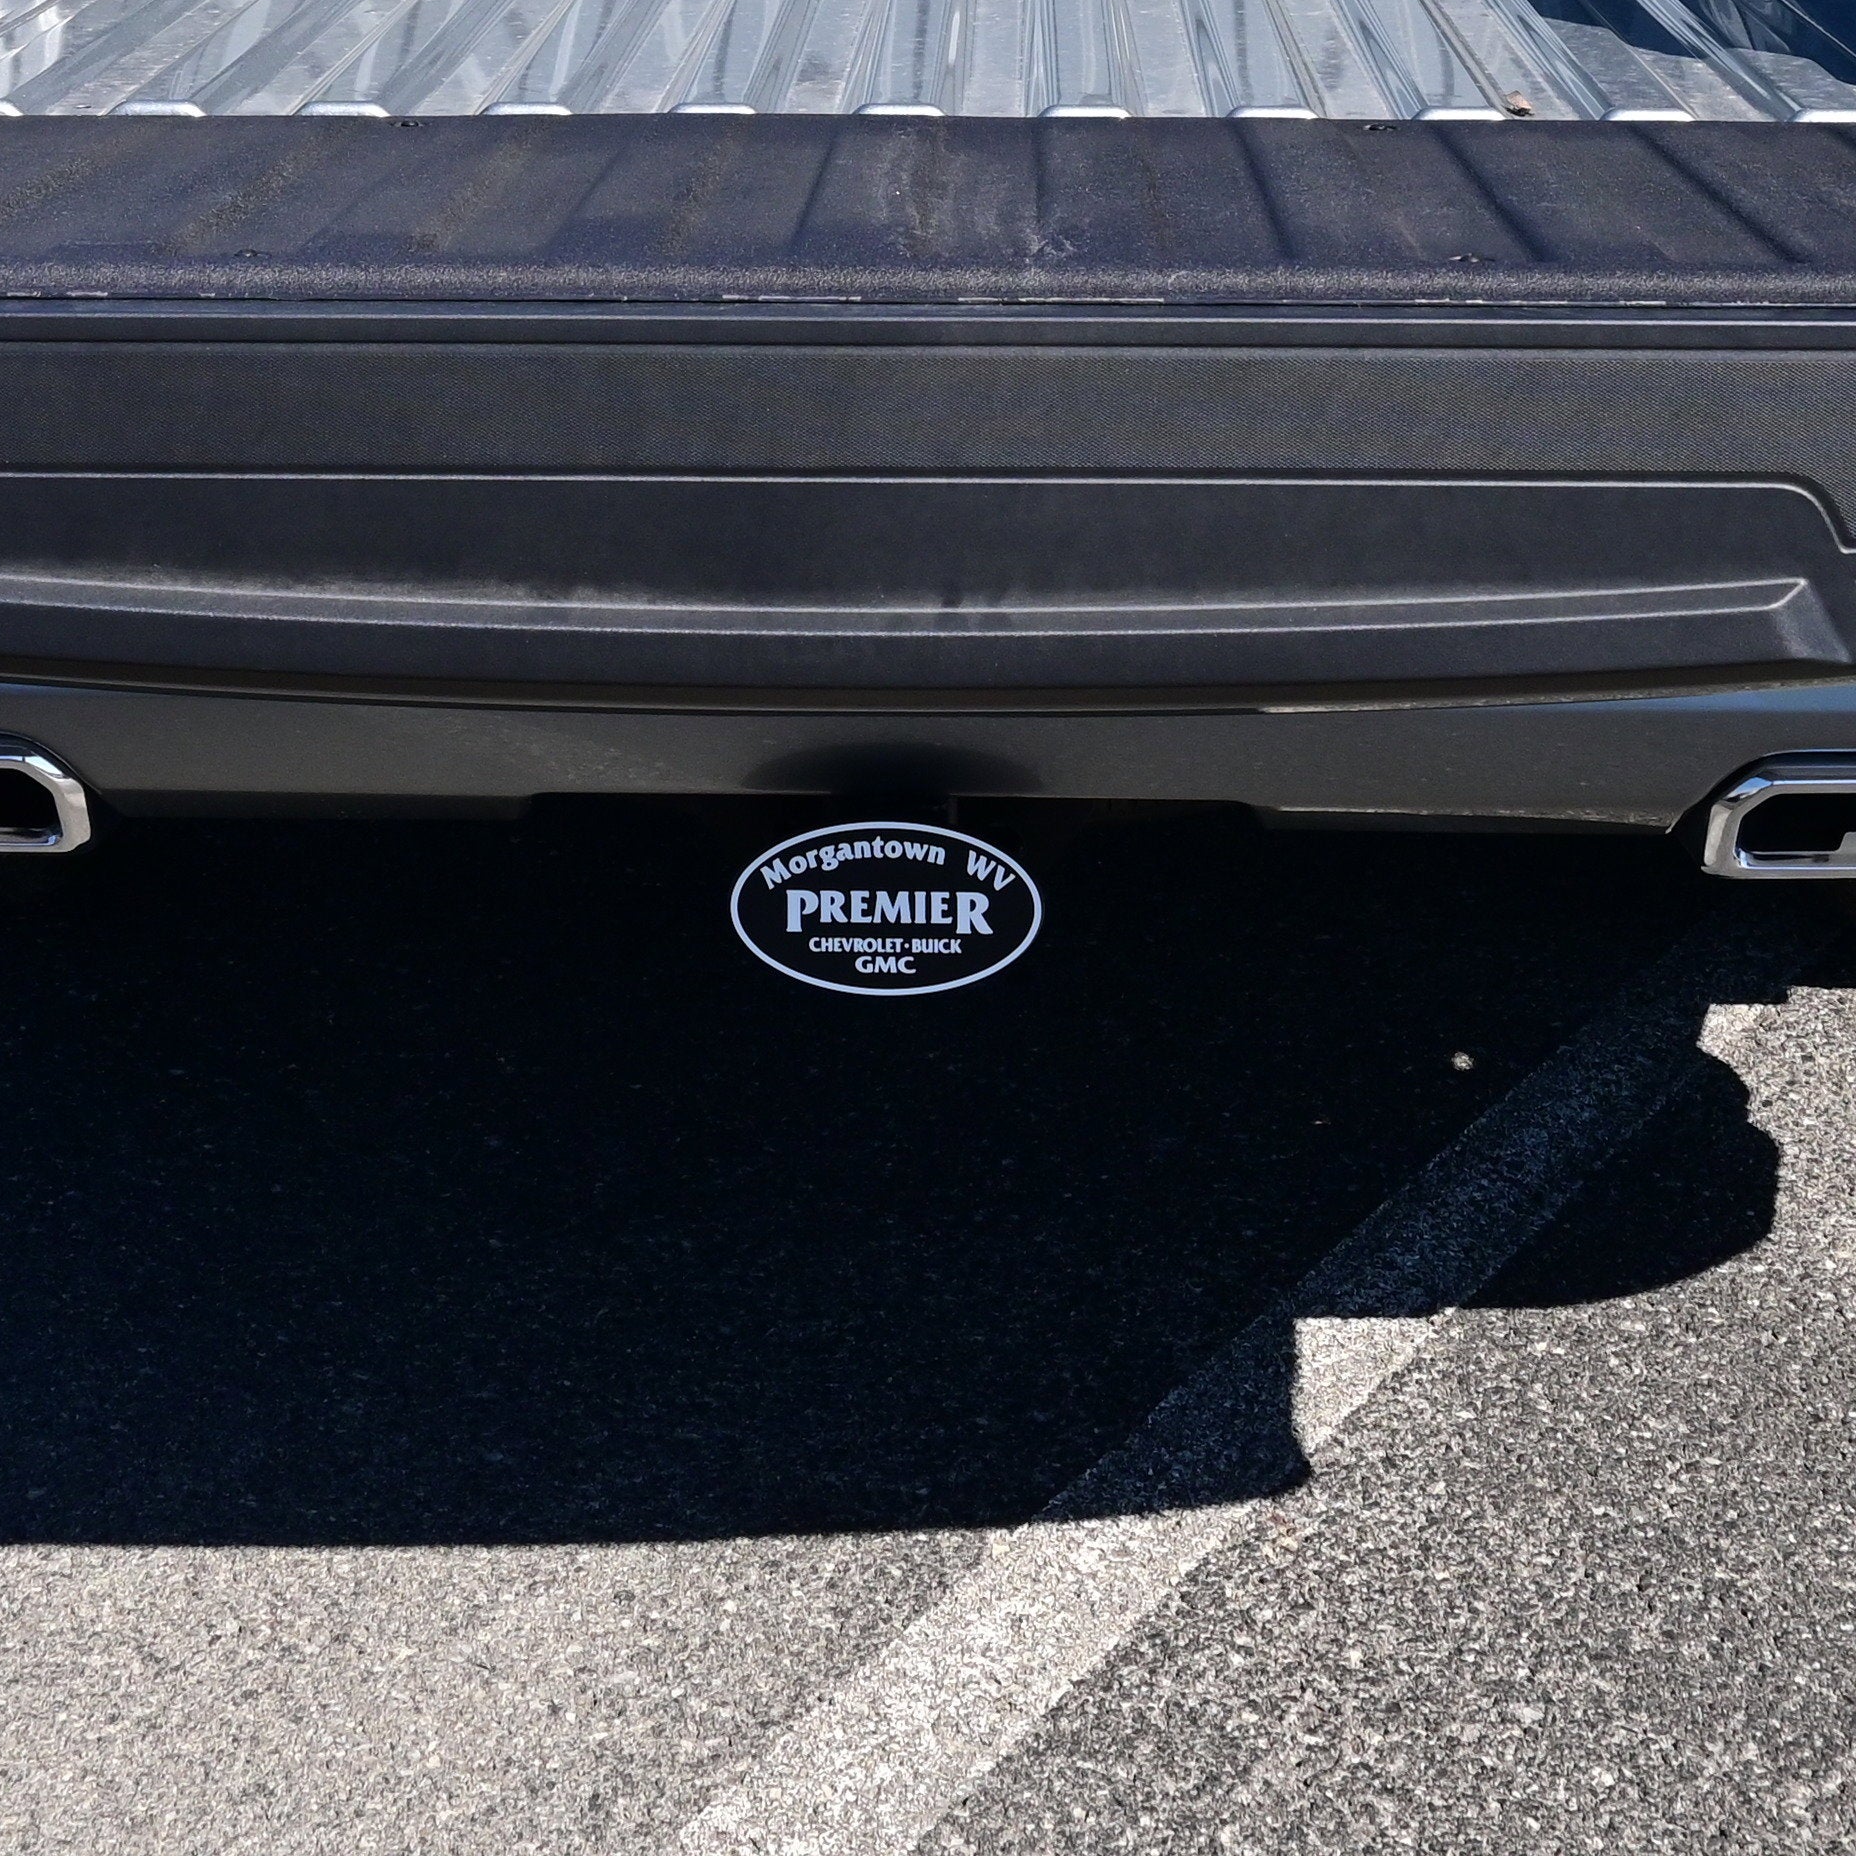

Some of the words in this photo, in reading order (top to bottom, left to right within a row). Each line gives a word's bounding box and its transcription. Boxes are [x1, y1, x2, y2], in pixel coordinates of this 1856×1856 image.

[760, 835, 945, 889] Morgantown
[966, 850, 1016, 891] WV
[785, 889, 993, 934] PREMIER
[855, 956, 916, 974] GMC
